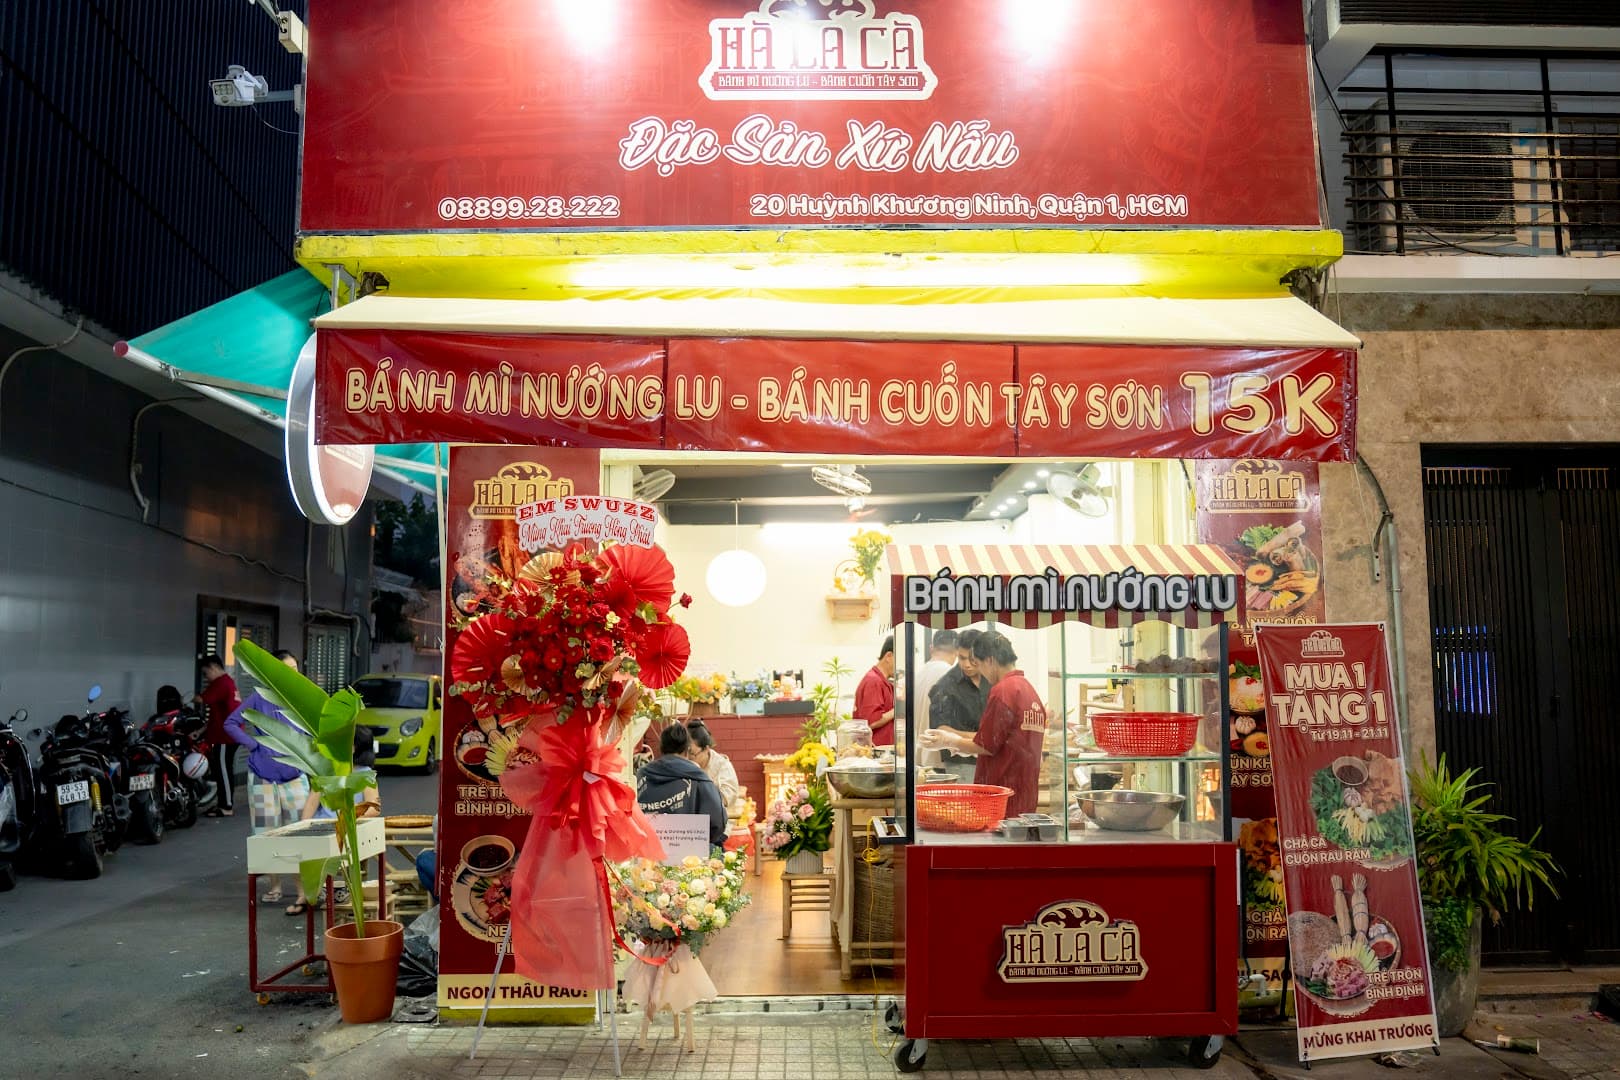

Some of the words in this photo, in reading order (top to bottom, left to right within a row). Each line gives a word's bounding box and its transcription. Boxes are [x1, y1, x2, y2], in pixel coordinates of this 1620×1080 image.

[718, 20, 775, 69] HÀ
[790, 27, 846, 69] LA
[860, 20, 918, 69] CÀ
[619, 116, 721, 177] Đặc
[723, 114, 831, 168] Sản
[835, 120, 913, 172] Xứ
[913, 120, 1019, 173] Nẫu
[438, 195, 620, 220] 08899.28.222
[750, 193, 786, 216] 20
[787, 192, 870, 220] Huỳnh
[871, 193, 972, 220] Khương
[973, 192, 1037, 220] Ninh,
[1038, 192, 1104, 221] Quận
[1104, 194, 1127, 220] 1,
[1127, 194, 1189, 216] HCM
[345, 357, 456, 414] BÁNH
[464, 361, 512, 416] MÌ
[520, 362, 665, 420] NƯỚNG
[674, 374, 723, 421] LU
[731, 394, 749, 409] -
[757, 366, 869, 424] BÁNH
[879, 360, 992, 428] CUỐN
[999, 373, 1078, 429] TÂY
[1084, 378, 1164, 430] SƠN
[1178, 371, 1340, 438] 15K
[477, 481, 503, 505] HÀ
[511, 483, 537, 505] LA
[1212, 475, 1237, 500] HÀ
[1245, 477, 1271, 500] LA
[1277, 474, 1306, 500] CÀ
[519, 500, 556, 520] EM
[564, 498, 656, 522] SWUZZ
[906, 566, 1002, 613] BÁNH
[1008, 566, 1060, 613] MÌ
[1064, 566, 1192, 613] NƯỚNG
[1194, 574, 1239, 613] LU
[1284, 662, 1353, 691] MUA
[1352, 662, 1366, 689] 1
[1271, 688, 1369, 733] TẶNG
[1370, 690, 1388, 723] 1
[1311, 728, 1326, 741] Từ
[1326, 728, 1353, 740] 19.11
[1361, 726, 1389, 739] 21.11
[1231, 772, 1248, 787] ÂY
[455, 800, 493, 816] BÌNH
[1284, 833, 1309, 849] CHẢ
[1320, 850, 1343, 863] RAU
[1008, 929, 1046, 964] HÀ
[1054, 933, 1092, 963] LA
[1101, 927, 1138, 962] CÀ
[1269, 926, 1287, 940] RA
[447, 986, 496, 1000] NGON
[1395, 983, 1425, 1000] ĐỊNH
[1303, 1031, 1344, 1049] MỪNG
[1346, 1029, 1377, 1044] KHAI
[1378, 1023, 1433, 1041] TRƯƠNG
